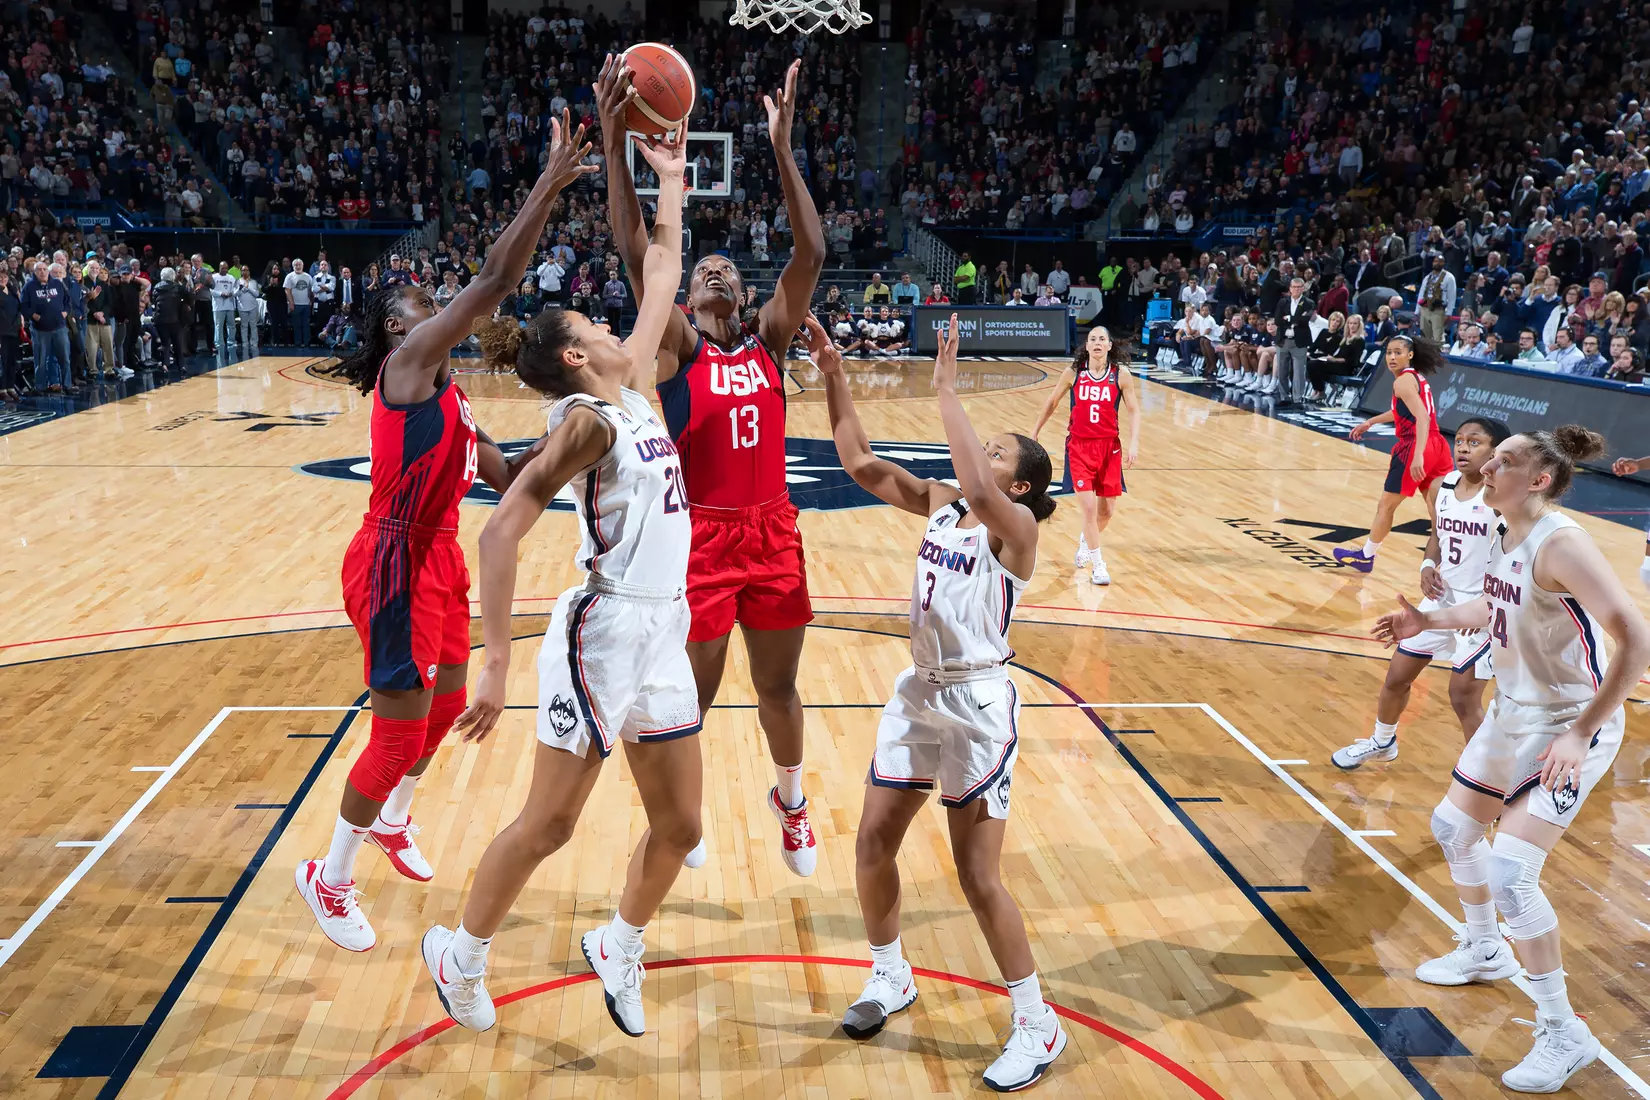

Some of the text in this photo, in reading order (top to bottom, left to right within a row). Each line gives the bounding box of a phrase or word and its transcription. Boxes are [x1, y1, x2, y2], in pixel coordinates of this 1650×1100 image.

[647, 75, 665, 96] FIBA
[932, 320, 977, 331] UCNN
[710, 359, 770, 397] USA
[1078, 385, 1111, 402] USA
[1463, 387, 1550, 415] TEAM PHYSICIANS
[1090, 404, 1100, 424] 6
[1456, 403, 1510, 421] UCONN ATHLETICS
[729, 404, 759, 449] 13
[664, 465, 689, 514] 20
[1437, 516, 1488, 537] UCONN
[1215, 517, 1345, 568] XL CENTER
[1448, 536, 1462, 565] 5
[921, 571, 937, 612] 3
[1483, 572, 1522, 606] CONN
